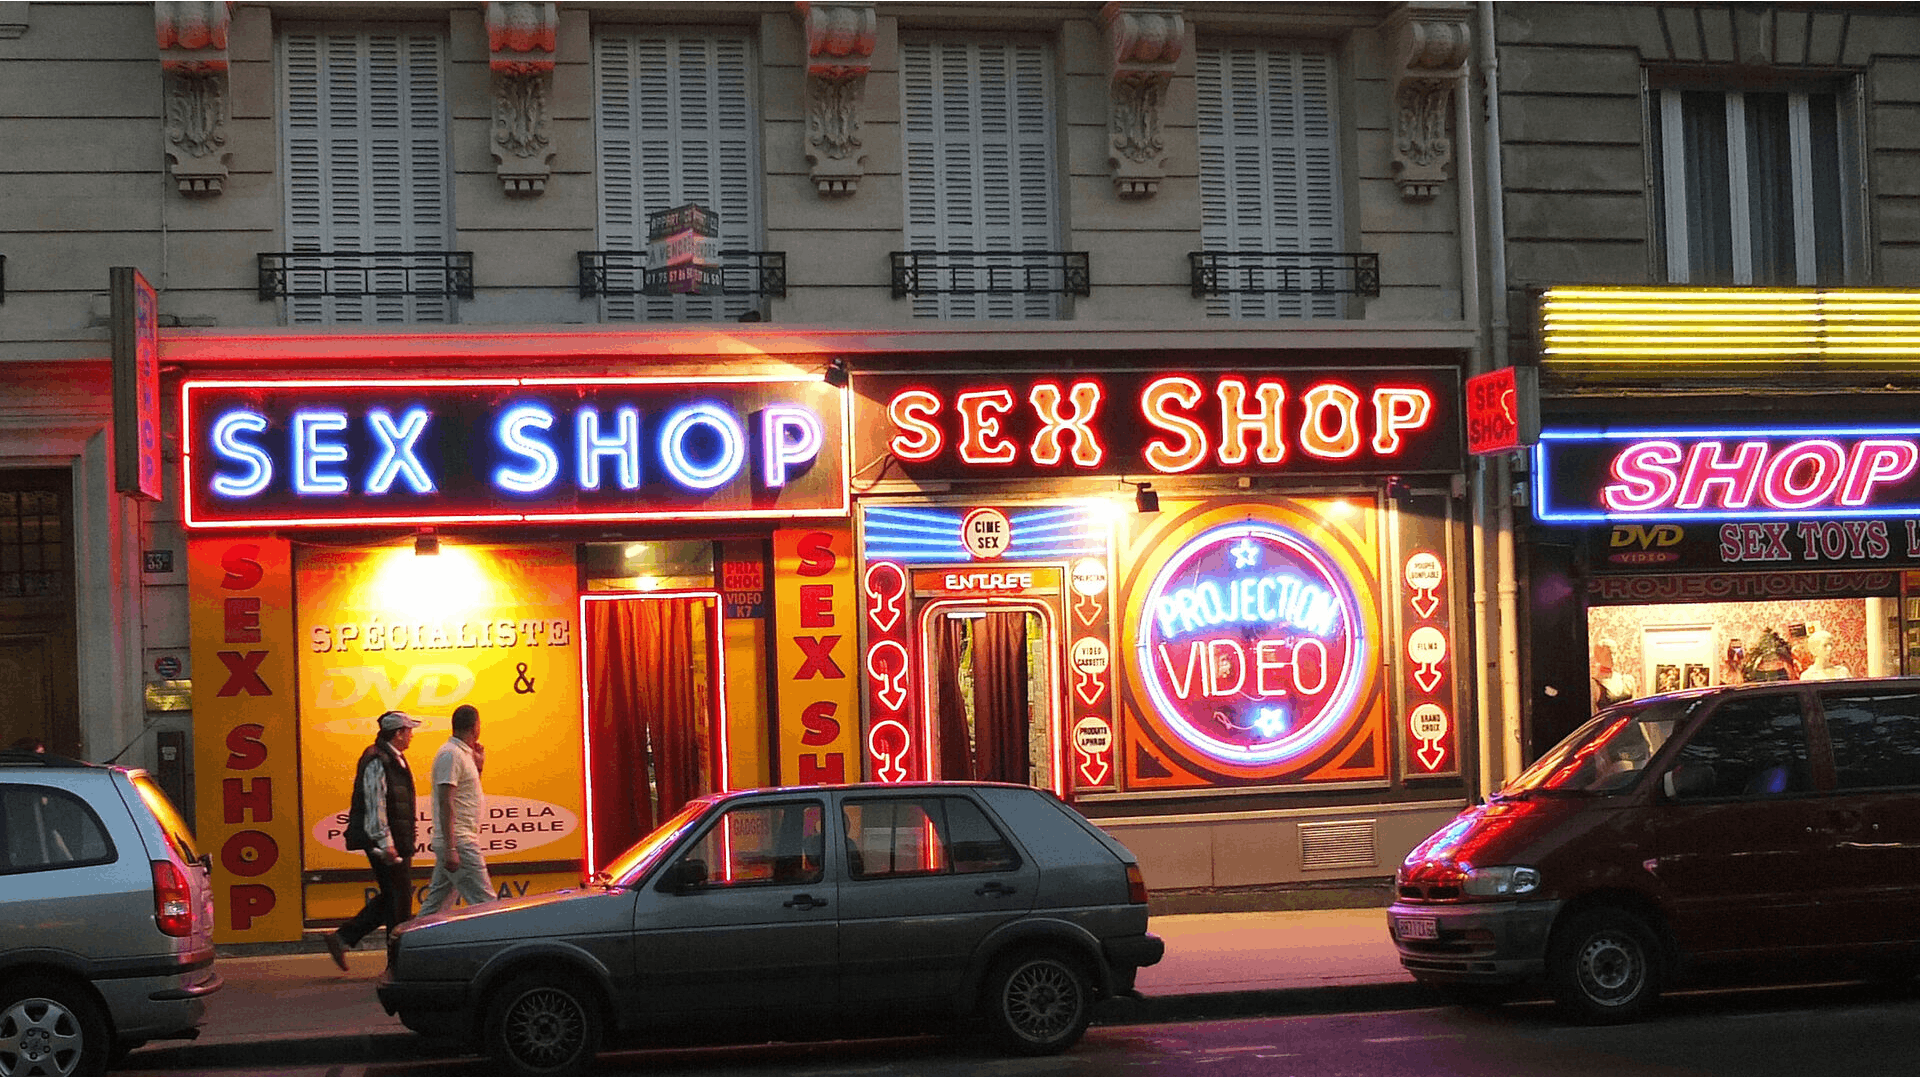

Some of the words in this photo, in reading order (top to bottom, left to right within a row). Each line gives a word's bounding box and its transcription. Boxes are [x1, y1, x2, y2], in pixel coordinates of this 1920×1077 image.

[1475, 377, 1509, 411] SEX
[889, 381, 1103, 468] SEX
[1142, 376, 1431, 473] SHOP
[1470, 414, 1513, 445] SHOP
[212, 407, 434, 496] SEX
[498, 404, 823, 493] SHOP
[1602, 439, 1919, 511] SHOP
[975, 520, 1001, 533] CINE
[1610, 525, 1685, 550] DVD
[1719, 522, 1792, 562] SEX
[1797, 521, 1890, 562] TOYS
[977, 536, 1000, 549] SEX
[726, 562, 760, 575] PRIX
[1620, 553, 1668, 564] VIDEO
[725, 575, 761, 588] CHOC
[945, 573, 1032, 591] ENTREE
[1588, 571, 1818, 599] PROJECTION
[1824, 572, 1893, 592] DVD
[726, 592, 762, 605] VIDEO
[736, 605, 752, 618] K7
[792, 532, 846, 681] SEX
[1156, 574, 1340, 638] PROJECTION
[215, 544, 274, 698] SEX
[310, 616, 570, 653] SPÉCIALISTE
[1081, 647, 1102, 655] VIDEO
[1158, 638, 1327, 699] VIDEO
[315, 663, 476, 711] DVD
[513, 662, 535, 694] &
[799, 701, 846, 785] SH
[1421, 723, 1441, 733] CHOIX
[220, 723, 279, 931] SHOP
[490, 808, 520, 819] DE
[527, 806, 555, 818] LA
